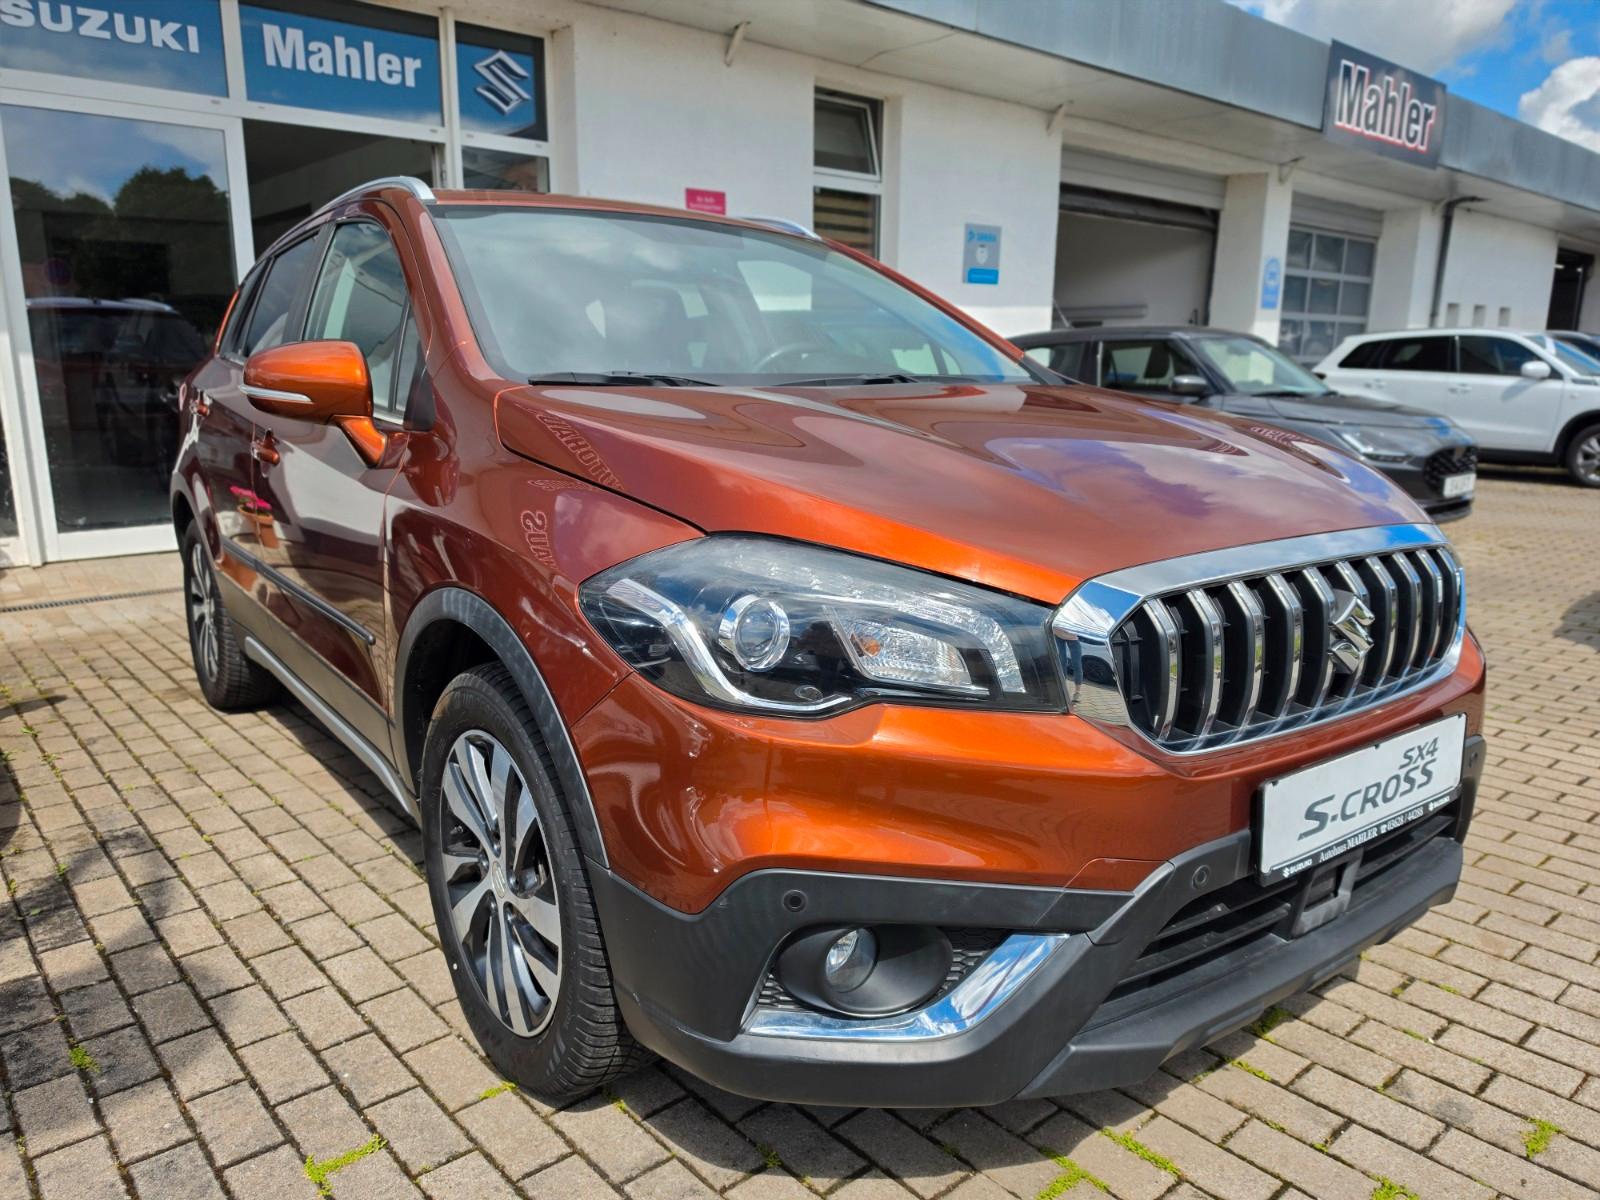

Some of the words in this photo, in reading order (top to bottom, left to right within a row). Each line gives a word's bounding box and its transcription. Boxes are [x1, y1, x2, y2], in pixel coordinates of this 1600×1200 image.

[0, 0, 200, 54] SUZUKI
[261, 22, 423, 89] Mahler
[1334, 58, 1437, 154] Mahler
[1398, 737, 1439, 770] SX4
[1297, 757, 1437, 842] S-CROSS
[1319, 843, 1347, 863] Autohaus
[1346, 826, 1379, 850] MAHLER
